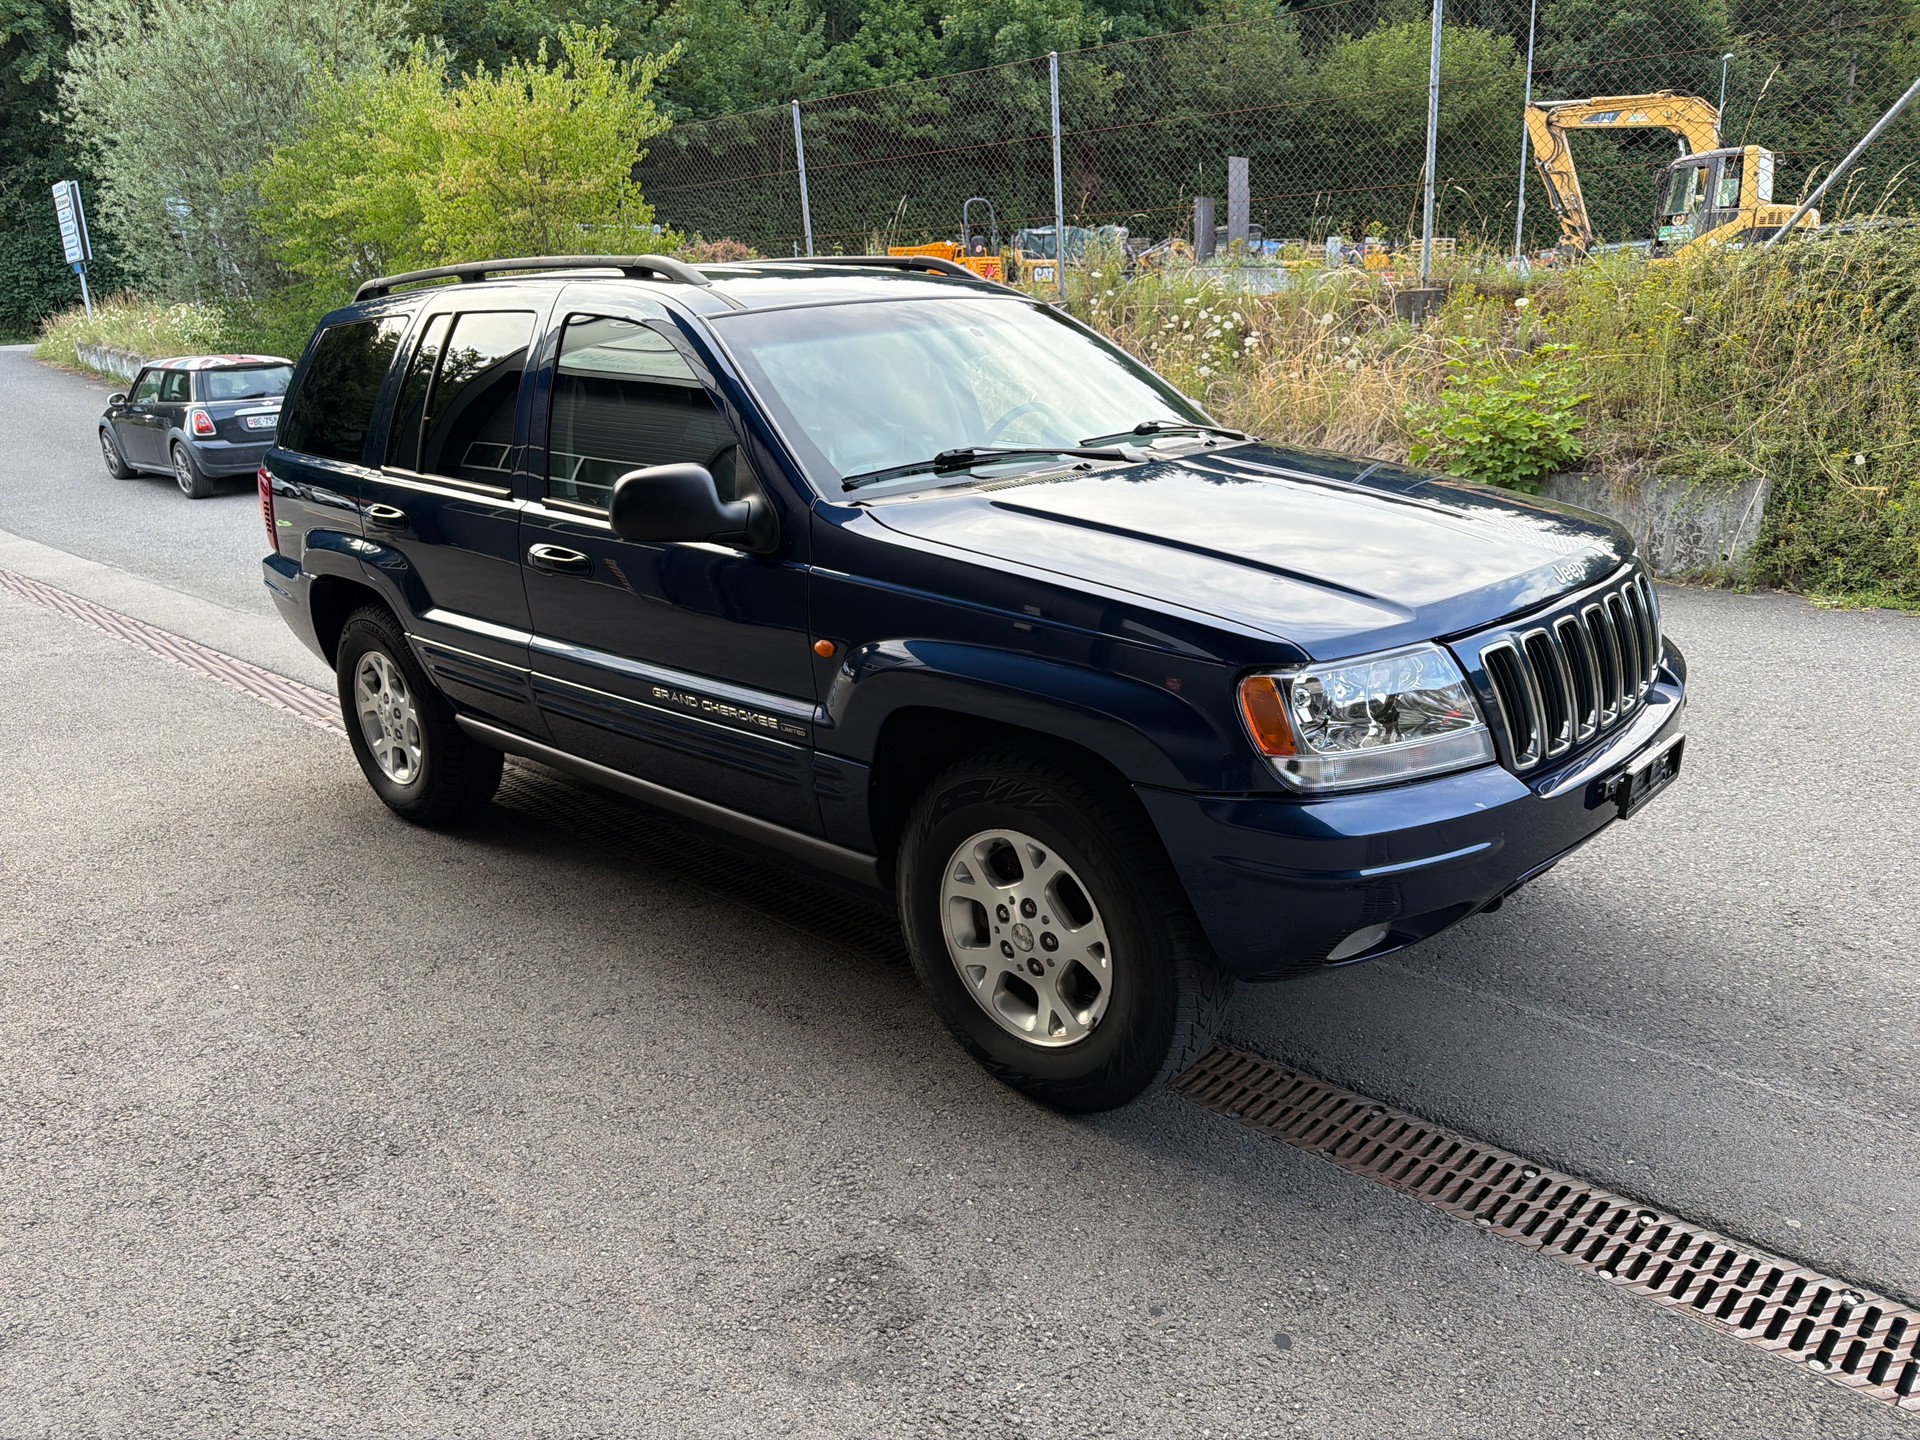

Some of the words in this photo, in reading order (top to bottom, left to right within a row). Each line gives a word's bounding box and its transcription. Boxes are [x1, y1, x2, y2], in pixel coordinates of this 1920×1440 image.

[1034, 267, 1054, 282] CAT
[1552, 562, 1586, 585] Jeep
[652, 687, 699, 708] GRAND
[702, 700, 778, 729] CHEROKEE
[781, 725, 806, 737] LIMITED
